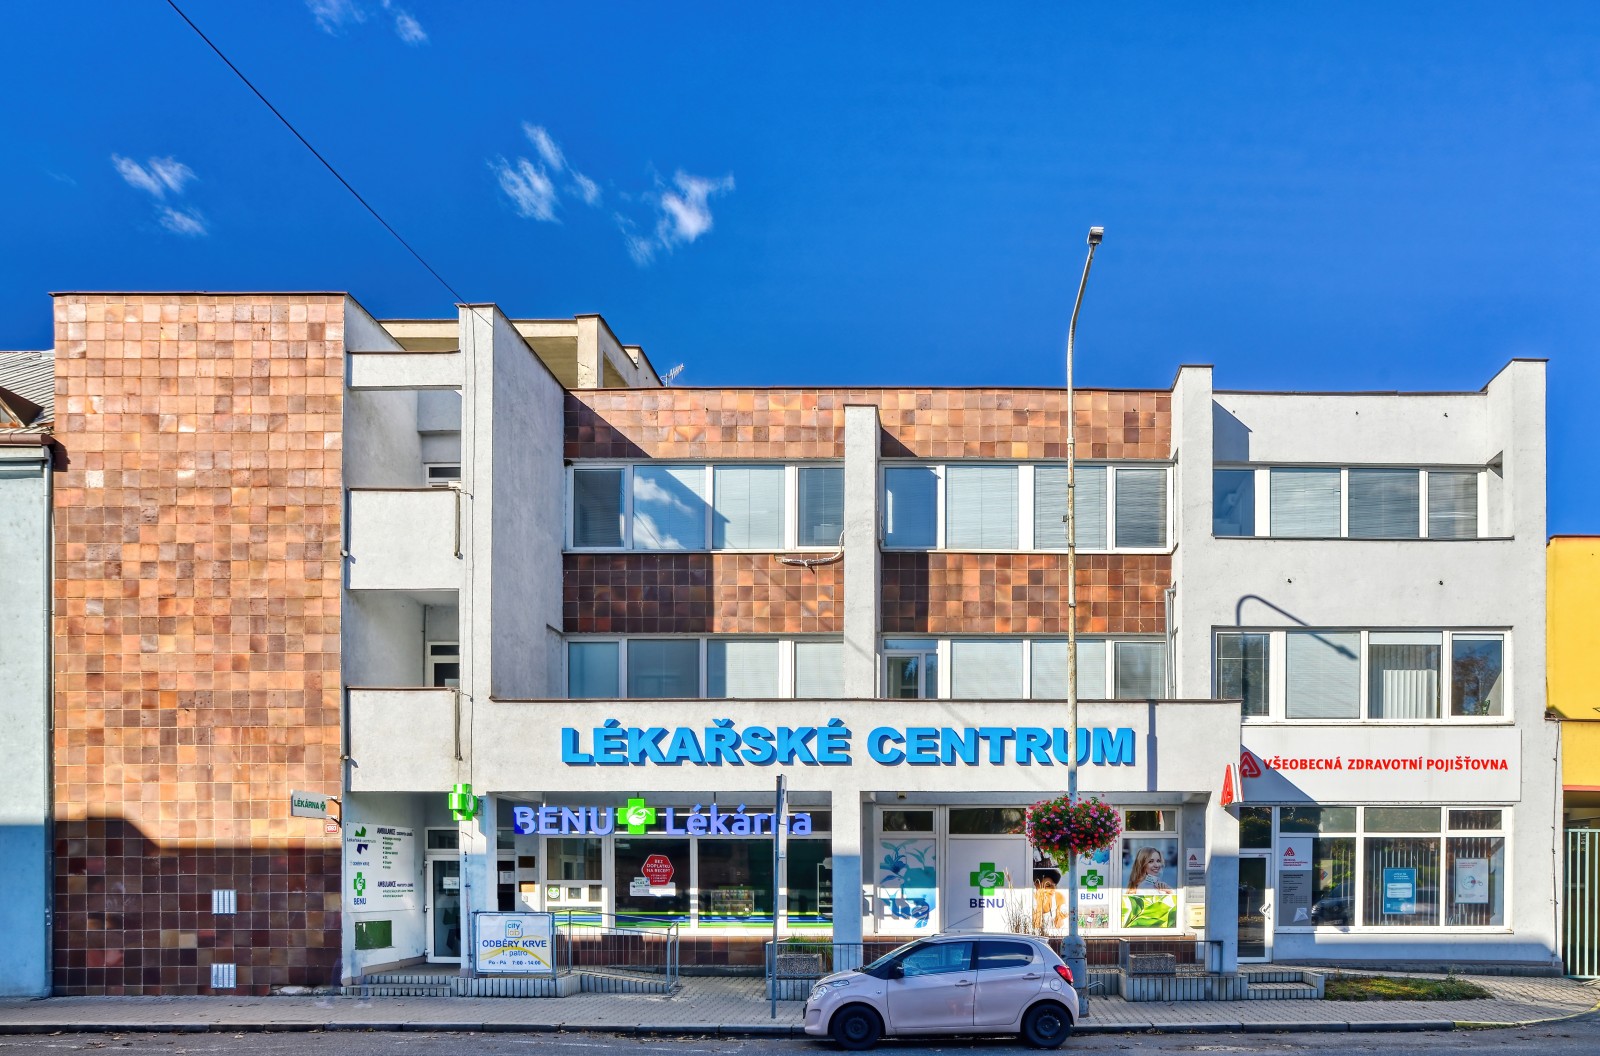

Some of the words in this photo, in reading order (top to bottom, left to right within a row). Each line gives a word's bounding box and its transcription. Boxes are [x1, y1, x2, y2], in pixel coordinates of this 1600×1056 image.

[562, 718, 851, 765] LÉKAŘSKÉ
[867, 726, 1135, 766] CENTRUM
[1263, 755, 1342, 770] VŠEOBECNÁ
[1347, 755, 1423, 770] ZDRAVOTNÍ
[1426, 755, 1508, 772] POJIŠŤOVNA
[294, 797, 320, 810] LÉKÁRNA
[513, 806, 614, 835] BENU
[353, 897, 367, 905] BENU
[969, 898, 1005, 908] BENU
[482, 939, 519, 947] ODBĚRY
